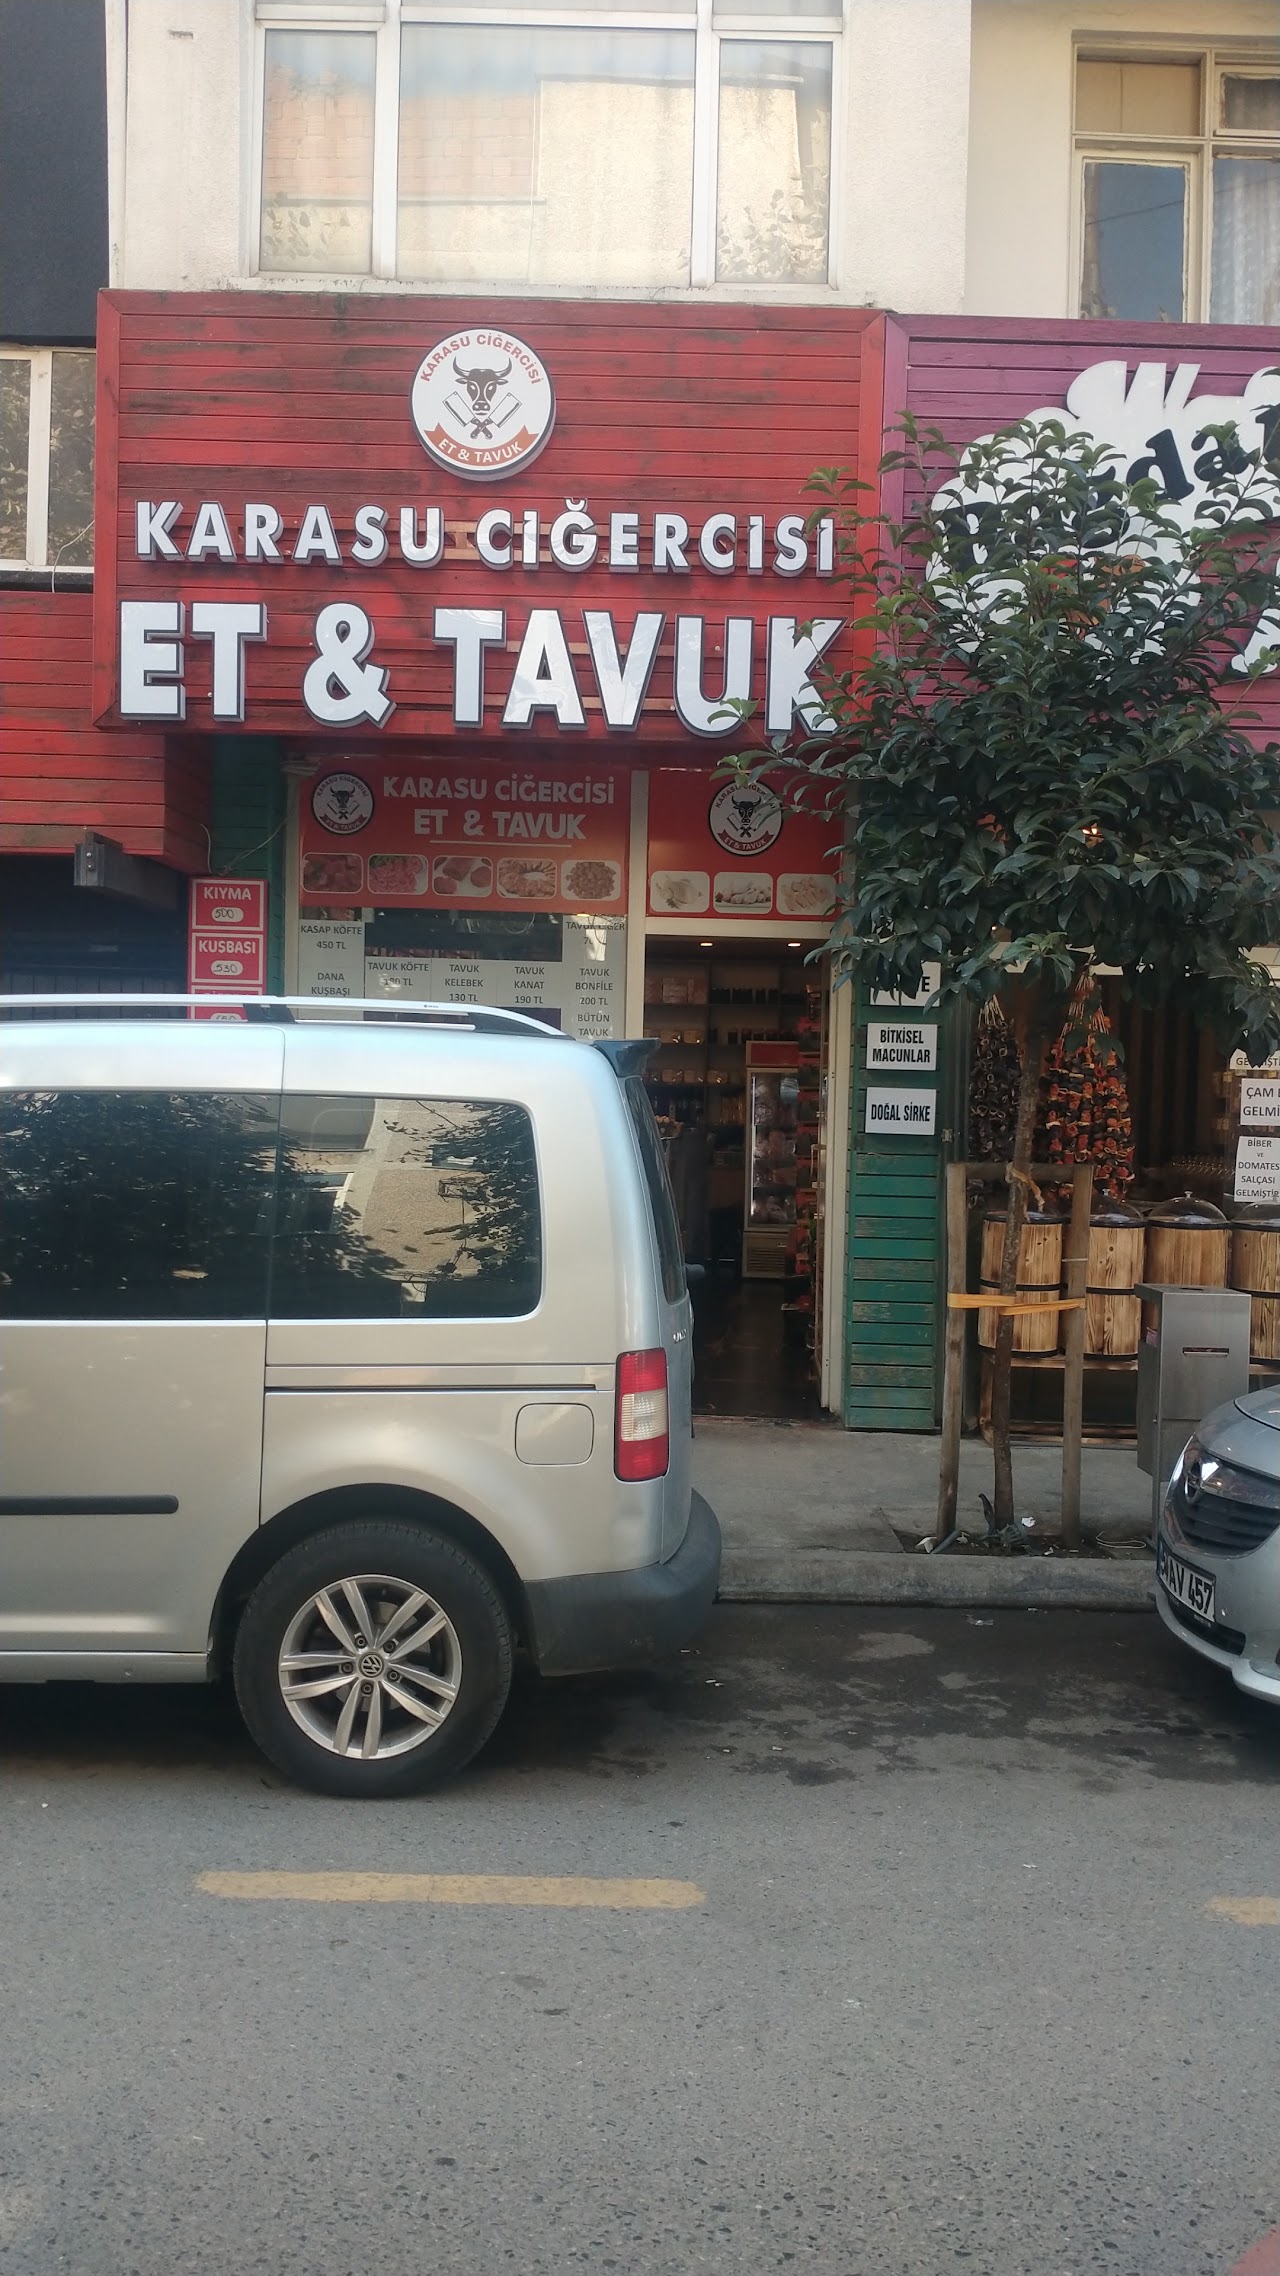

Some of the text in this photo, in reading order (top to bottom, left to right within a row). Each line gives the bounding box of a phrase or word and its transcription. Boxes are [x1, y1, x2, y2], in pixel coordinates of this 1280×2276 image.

[420, 332, 544, 385] KARASU CİĞERCİSİ
[438, 438, 523, 463] ET & TAVUK
[136, 500, 445, 567] KARASU
[120, 601, 848, 737] ET & TAVUK
[383, 773, 615, 804] KARASU CİĞERCİSİ
[414, 808, 587, 840] ET & TAVUK
[724, 837, 733, 846] ET
[742, 839, 767, 850] TAVUK
[203, 887, 252, 900] KIYMA
[214, 908, 235, 919] 500
[300, 925, 362, 935] KASAP KÖFTE
[316, 941, 346, 950] 450 TL
[214, 963, 238, 974] 530
[368, 961, 429, 971] TAVUK KÖFTE
[449, 964, 480, 973] TAVUK
[514, 966, 545, 975] TAVUK
[317, 973, 345, 981] DANA
[579, 968, 610, 976] TAVUK
[403, 978, 413, 986] TL
[444, 978, 484, 987] KELEBEK
[514, 981, 545, 990] KANAT
[575, 981, 614, 991] BONFİLE
[311, 987, 350, 997] KUŞBAŞI
[449, 993, 478, 1002] 130 TL
[515, 995, 544, 1004] 190 TL
[579, 997, 609, 1006] 200 TL
[577, 1012, 610, 1022] BÜTÜN
[578, 1028, 609, 1037] TAVUK
[880, 1026, 924, 1044] BİTKİSEL
[872, 1048, 931, 1063] MACUNLAR
[1246, 1087, 1274, 1099] ÇAM
[871, 1101, 931, 1122] DOĞAL SİRKE
[1247, 1138, 1272, 1148] BİBER
[1238, 1161, 1280, 1171] DOMATES
[1241, 1175, 1275, 1186] SALÇASI
[1188, 1573, 1213, 1615] 457
